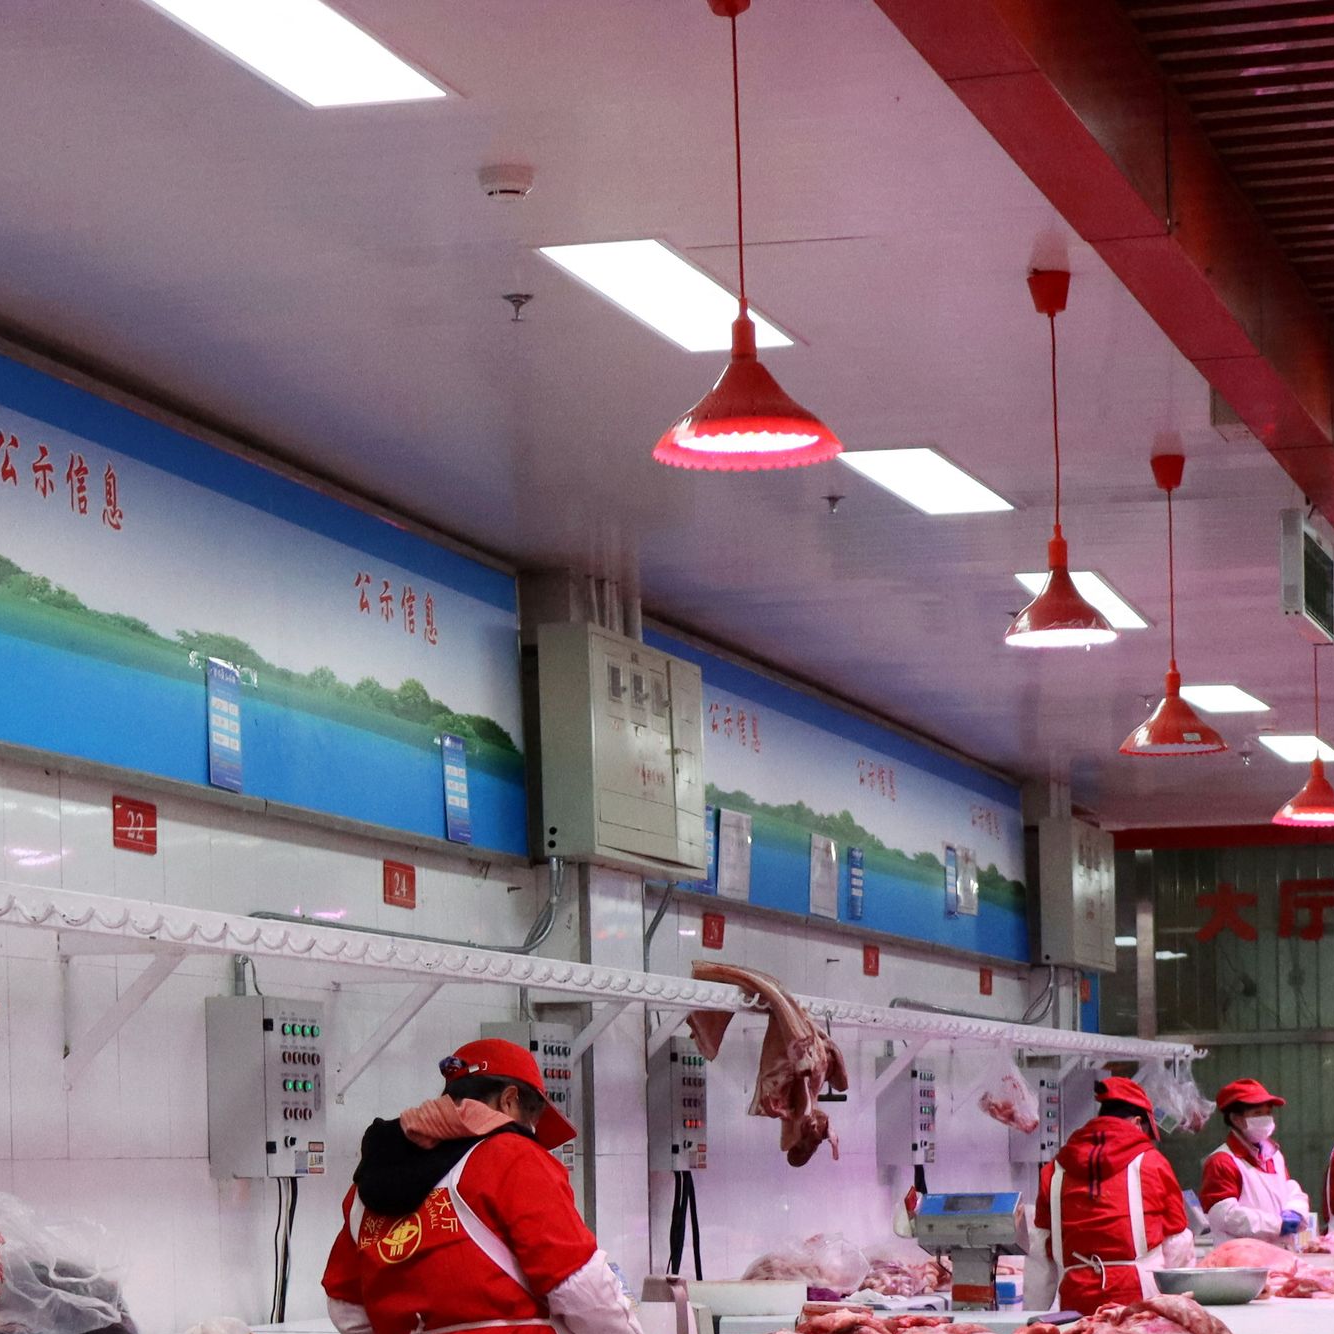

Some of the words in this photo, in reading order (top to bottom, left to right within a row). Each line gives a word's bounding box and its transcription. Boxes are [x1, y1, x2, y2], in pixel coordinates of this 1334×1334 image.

[354, 571, 438, 646] 公示信息
[127, 810, 144, 841] 22
[393, 871, 407, 897] 24
